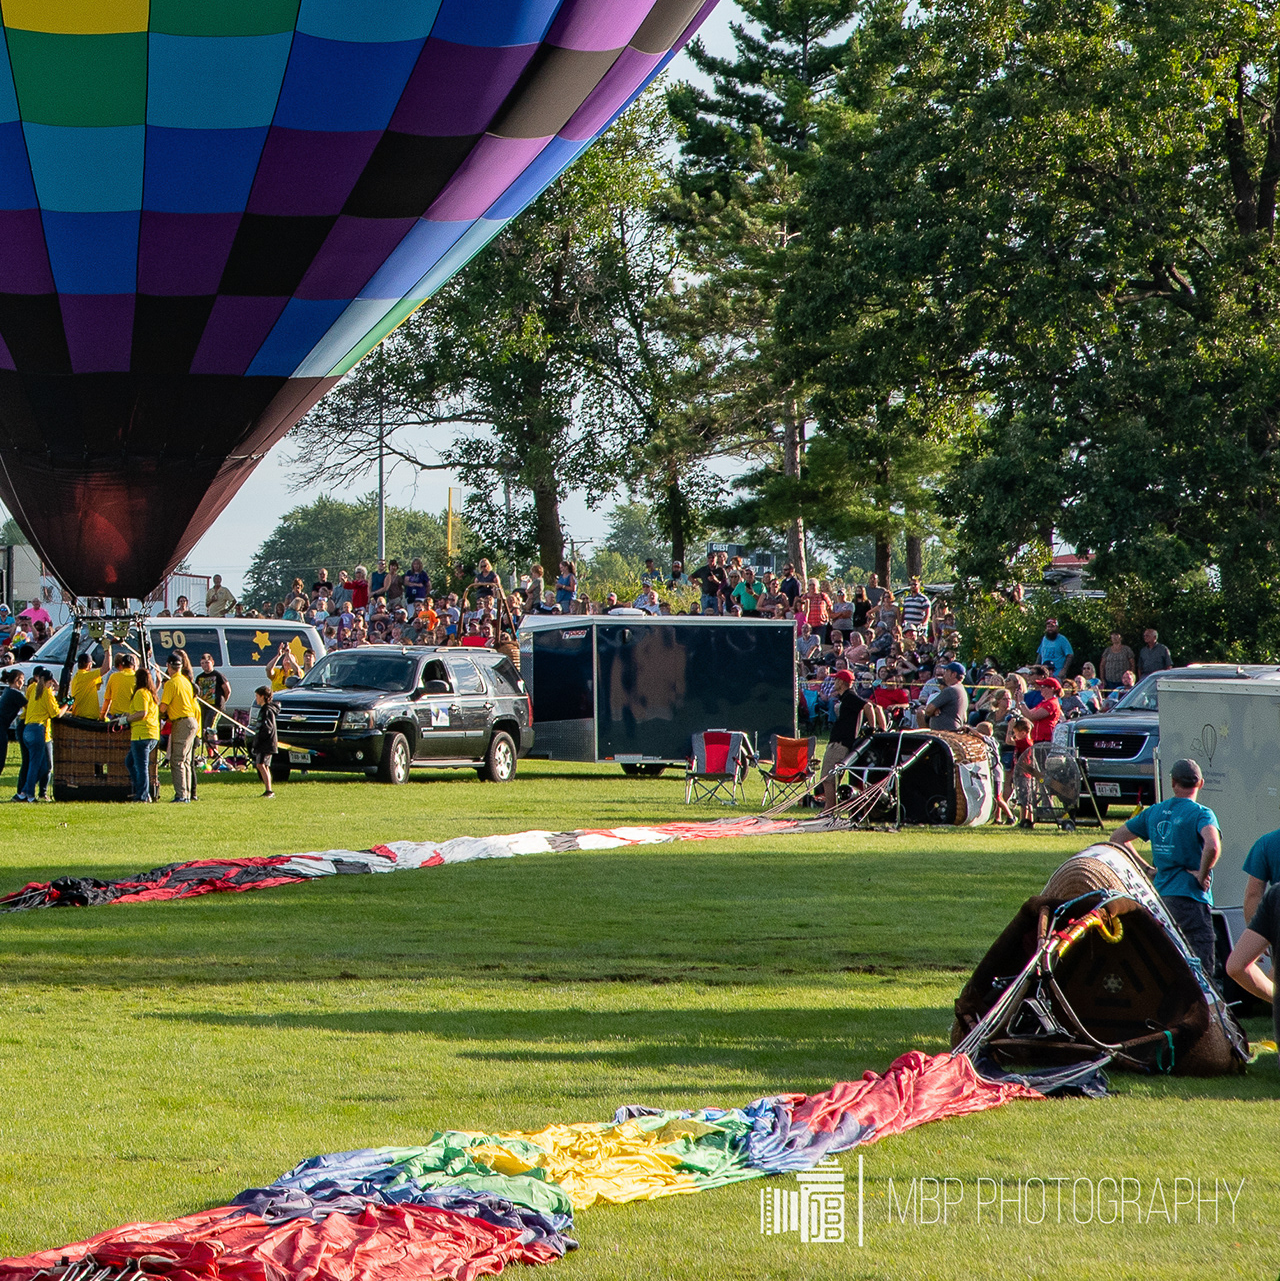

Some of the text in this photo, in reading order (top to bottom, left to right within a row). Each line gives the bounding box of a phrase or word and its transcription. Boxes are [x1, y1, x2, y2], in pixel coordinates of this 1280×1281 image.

[712, 543, 729, 552] GUEST
[159, 630, 186, 649] 50
[1094, 740, 1123, 750] GMC
